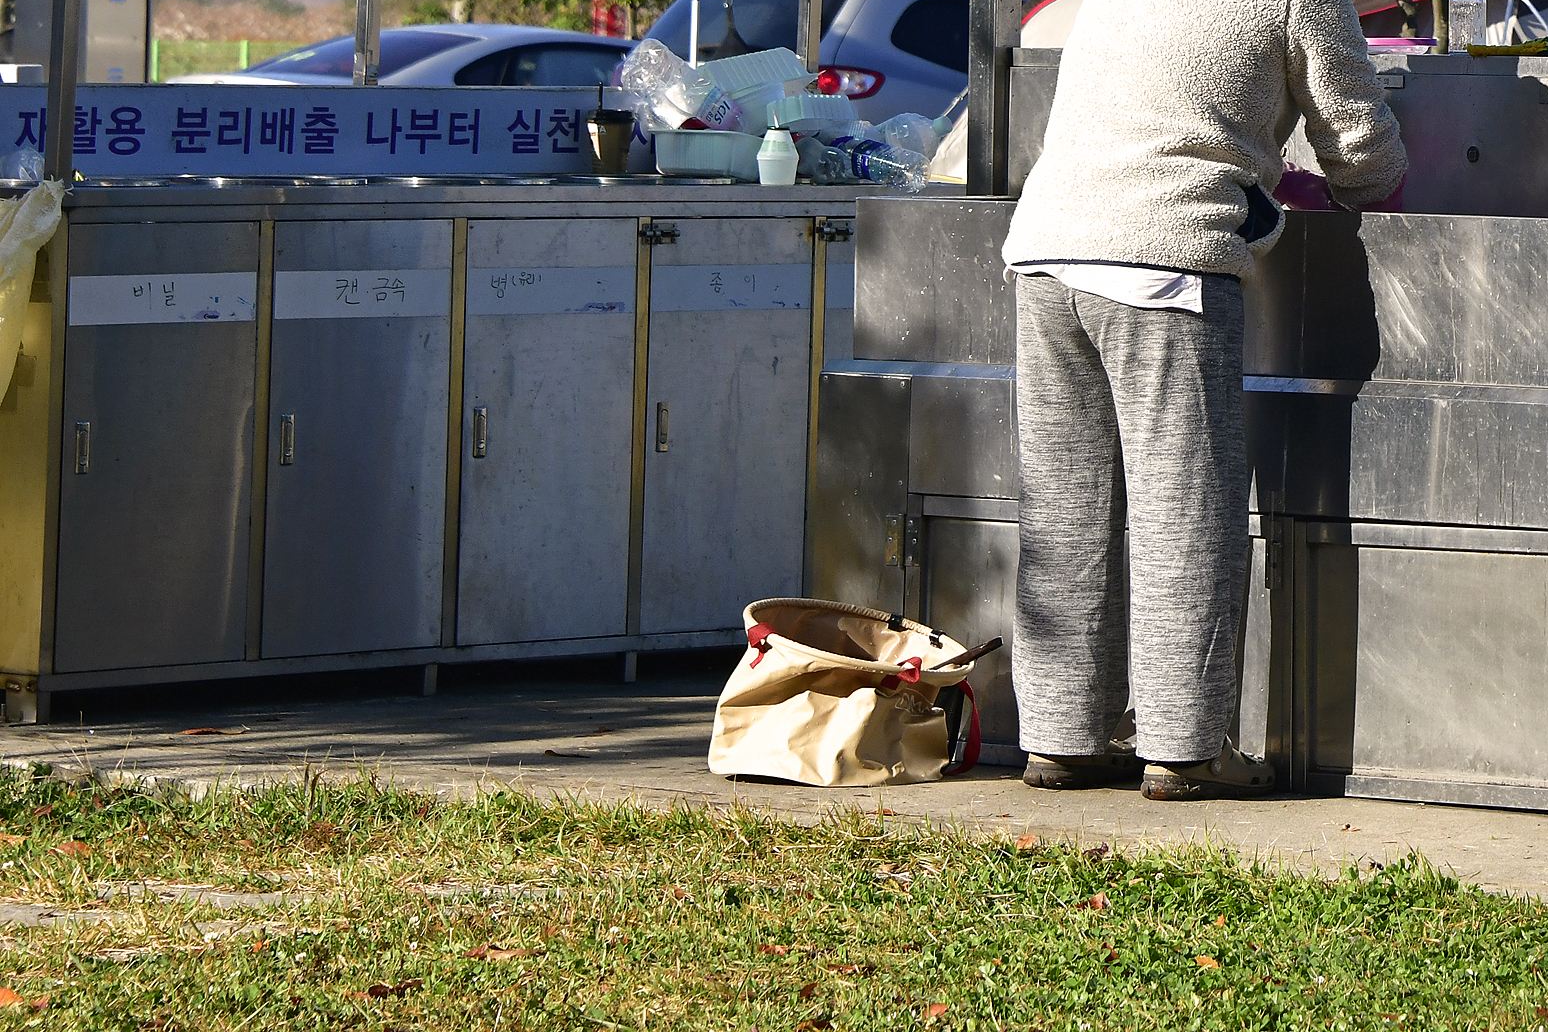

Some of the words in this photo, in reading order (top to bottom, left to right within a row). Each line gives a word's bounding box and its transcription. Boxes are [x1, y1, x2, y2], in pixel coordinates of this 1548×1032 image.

[14, 105, 147, 156] 재활용
[171, 106, 339, 155] 분리배출
[365, 107, 481, 155] 나부터
